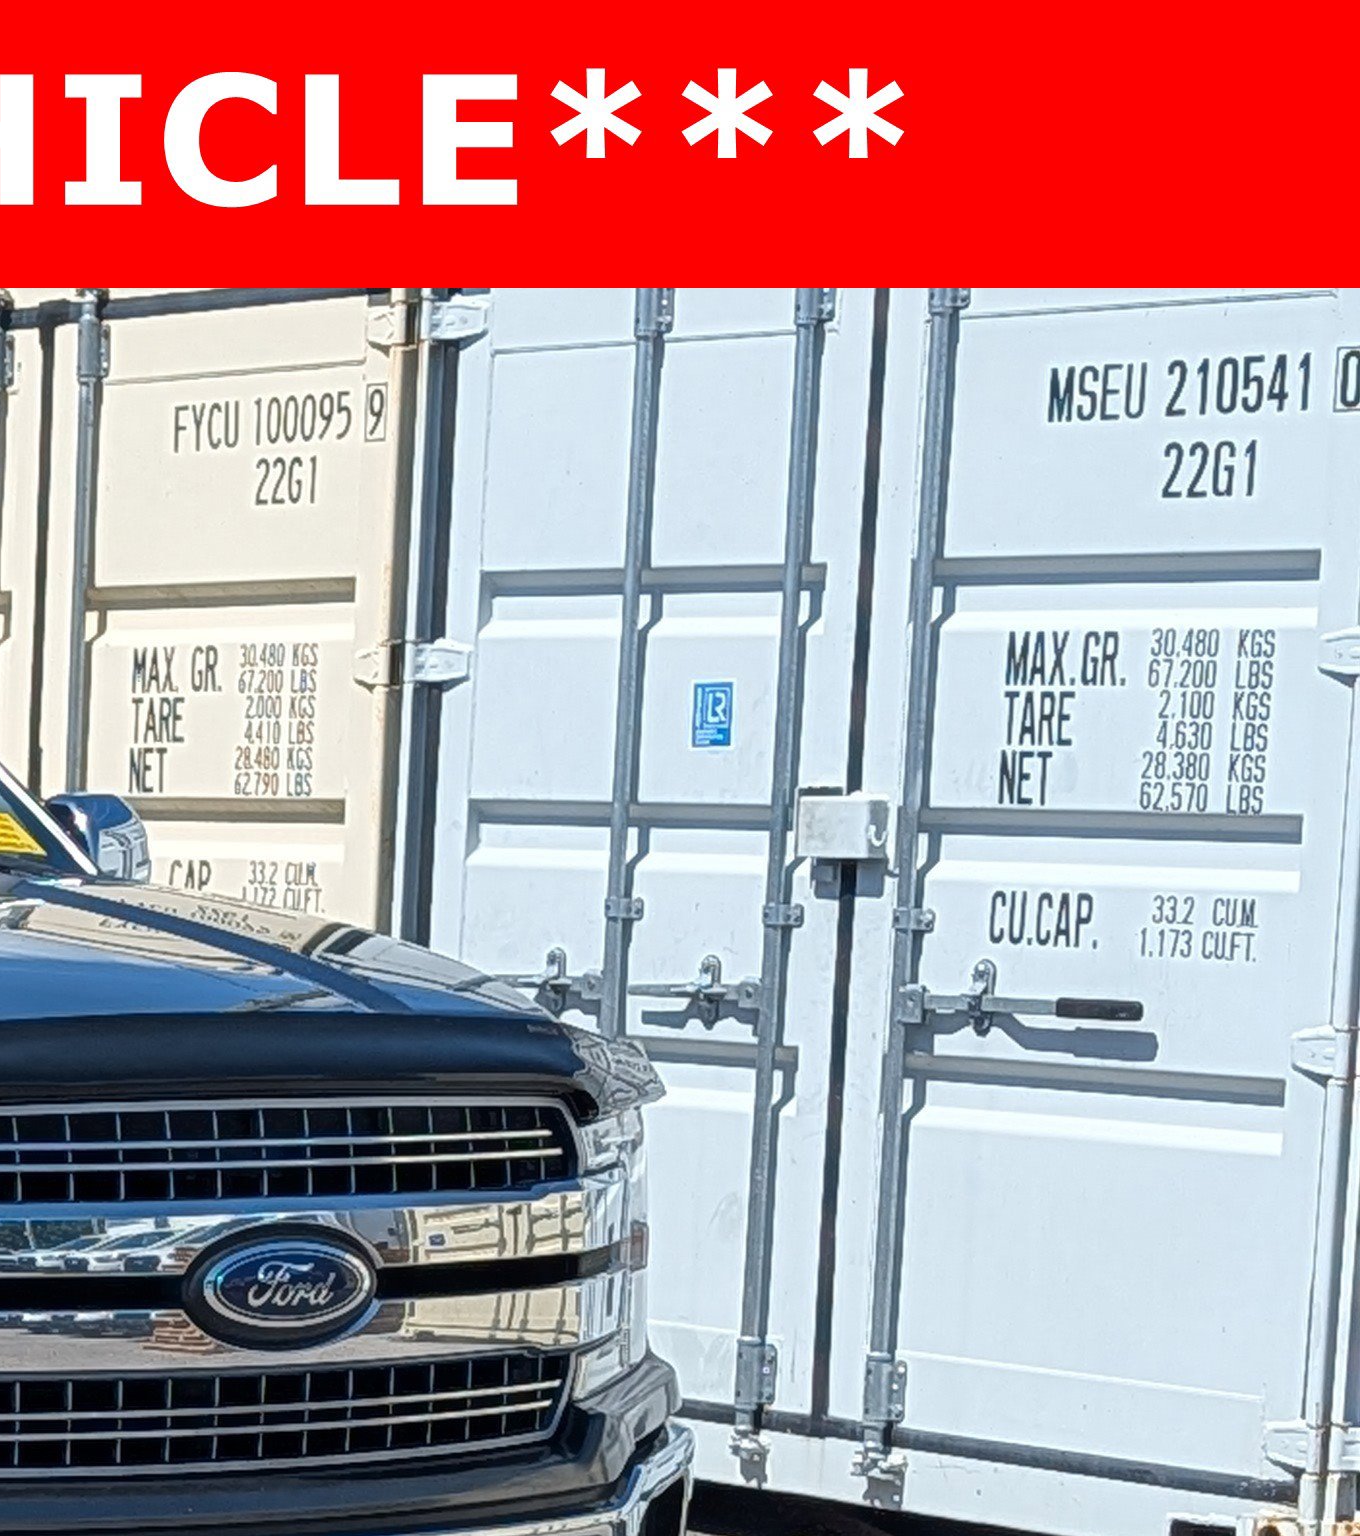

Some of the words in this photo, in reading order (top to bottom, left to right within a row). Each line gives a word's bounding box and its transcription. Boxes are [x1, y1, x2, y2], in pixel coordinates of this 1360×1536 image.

[1047, 361, 1148, 423] MSEU
[1164, 352, 1312, 417] 210541
[174, 400, 240, 453] FYCU
[254, 390, 353, 446] 100095
[368, 387, 386, 437] 9
[255, 455, 318, 506] 22G1
[1161, 439, 1258, 499] 22G1
[292, 643, 319, 667] KGS
[1237, 629, 1277, 659] KGS
[191, 644, 223, 692] GR.
[290, 669, 317, 693] LBS
[1235, 660, 1274, 690] LBS
[131, 697, 185, 743] TARE
[288, 695, 317, 719] KGS
[1004, 690, 1076, 747] TARE
[1231, 690, 1272, 721] KGS
[288, 720, 315, 745] LBS
[1229, 722, 1269, 752] LBS
[128, 747, 168, 793] NET
[287, 746, 314, 771] KGS
[1227, 752, 1267, 783] KGS
[286, 772, 313, 797] LBS
[997, 749, 1054, 806] NET
[1225, 784, 1265, 815] LBS
[248, 860, 278, 886] 33.2
[247, 1260, 337, 1308] Ford
